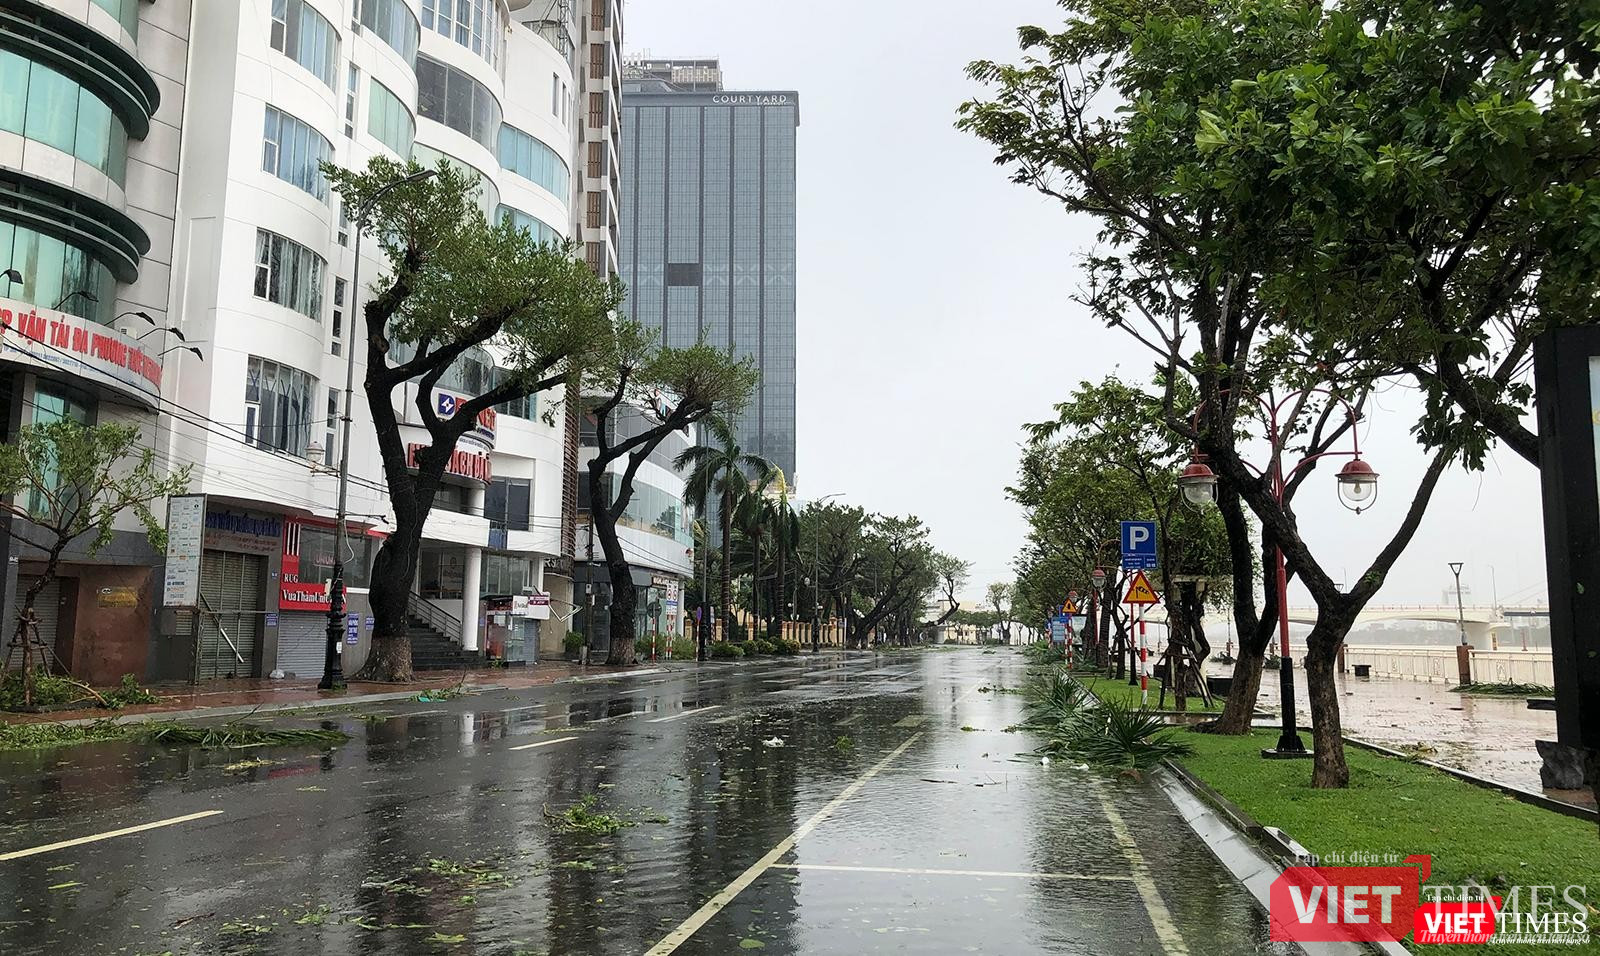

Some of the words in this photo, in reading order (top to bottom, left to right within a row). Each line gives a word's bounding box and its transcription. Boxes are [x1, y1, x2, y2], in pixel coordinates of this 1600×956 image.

[712, 94, 787, 103] COURTYARD
[18, 309, 47, 346] VẬN
[50, 314, 71, 349] TẢI
[1129, 526, 1150, 550] P
[284, 573, 299, 583] RUG
